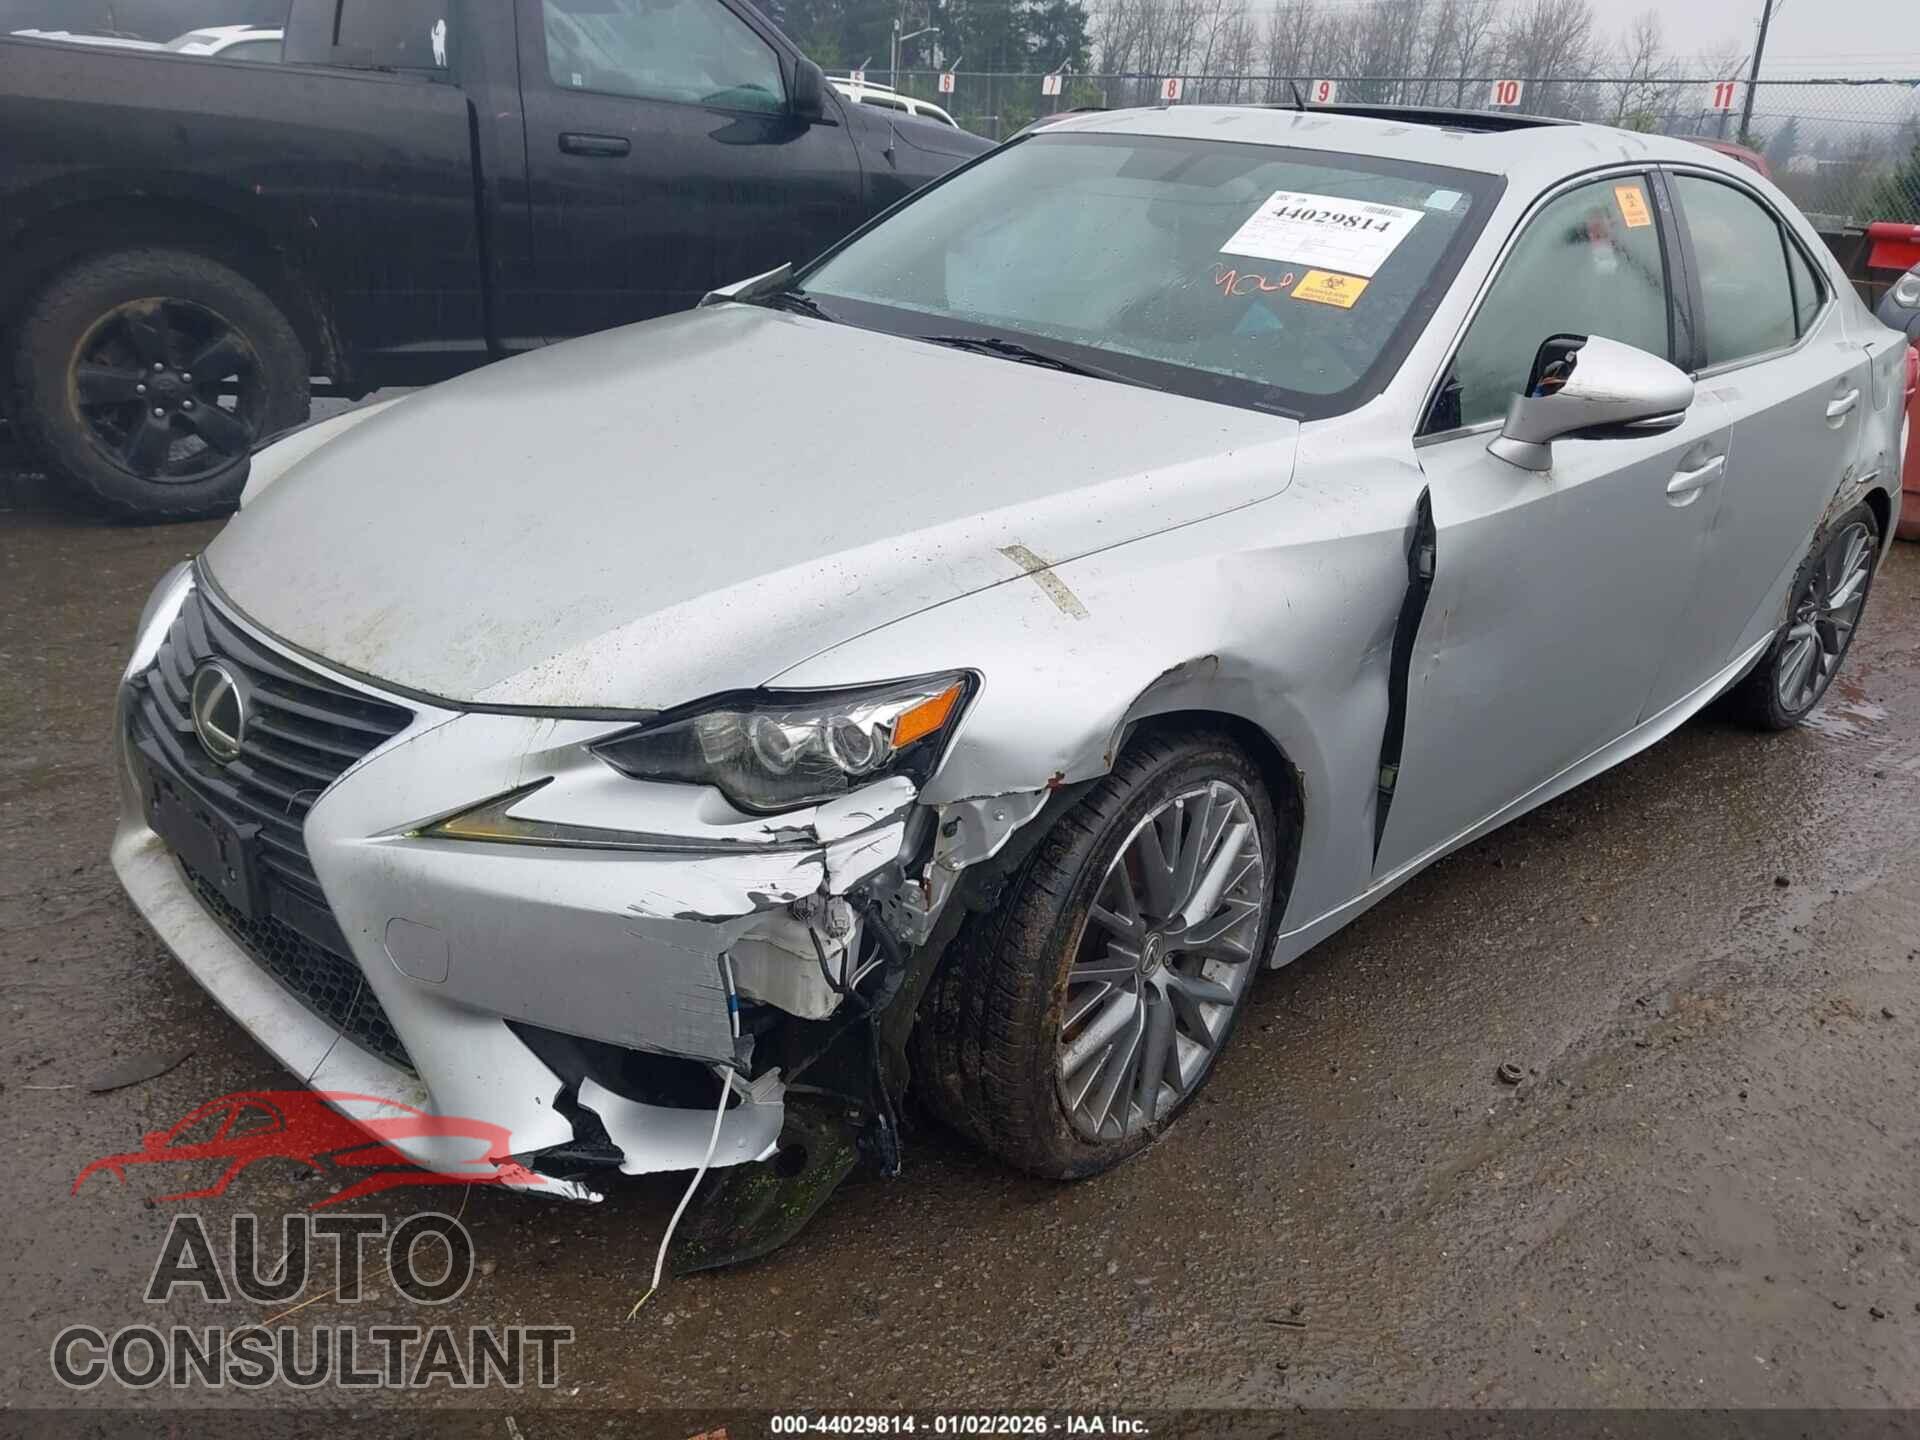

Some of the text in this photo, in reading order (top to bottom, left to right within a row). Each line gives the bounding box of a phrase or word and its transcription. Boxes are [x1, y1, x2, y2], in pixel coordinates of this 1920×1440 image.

[943, 75, 950, 90] 6
[1167, 79, 1177, 98] 8
[1318, 81, 1329, 102] 9
[1496, 81, 1518, 104] 10
[1714, 82, 1734, 107] 11
[1272, 206, 1391, 232] 44029814
